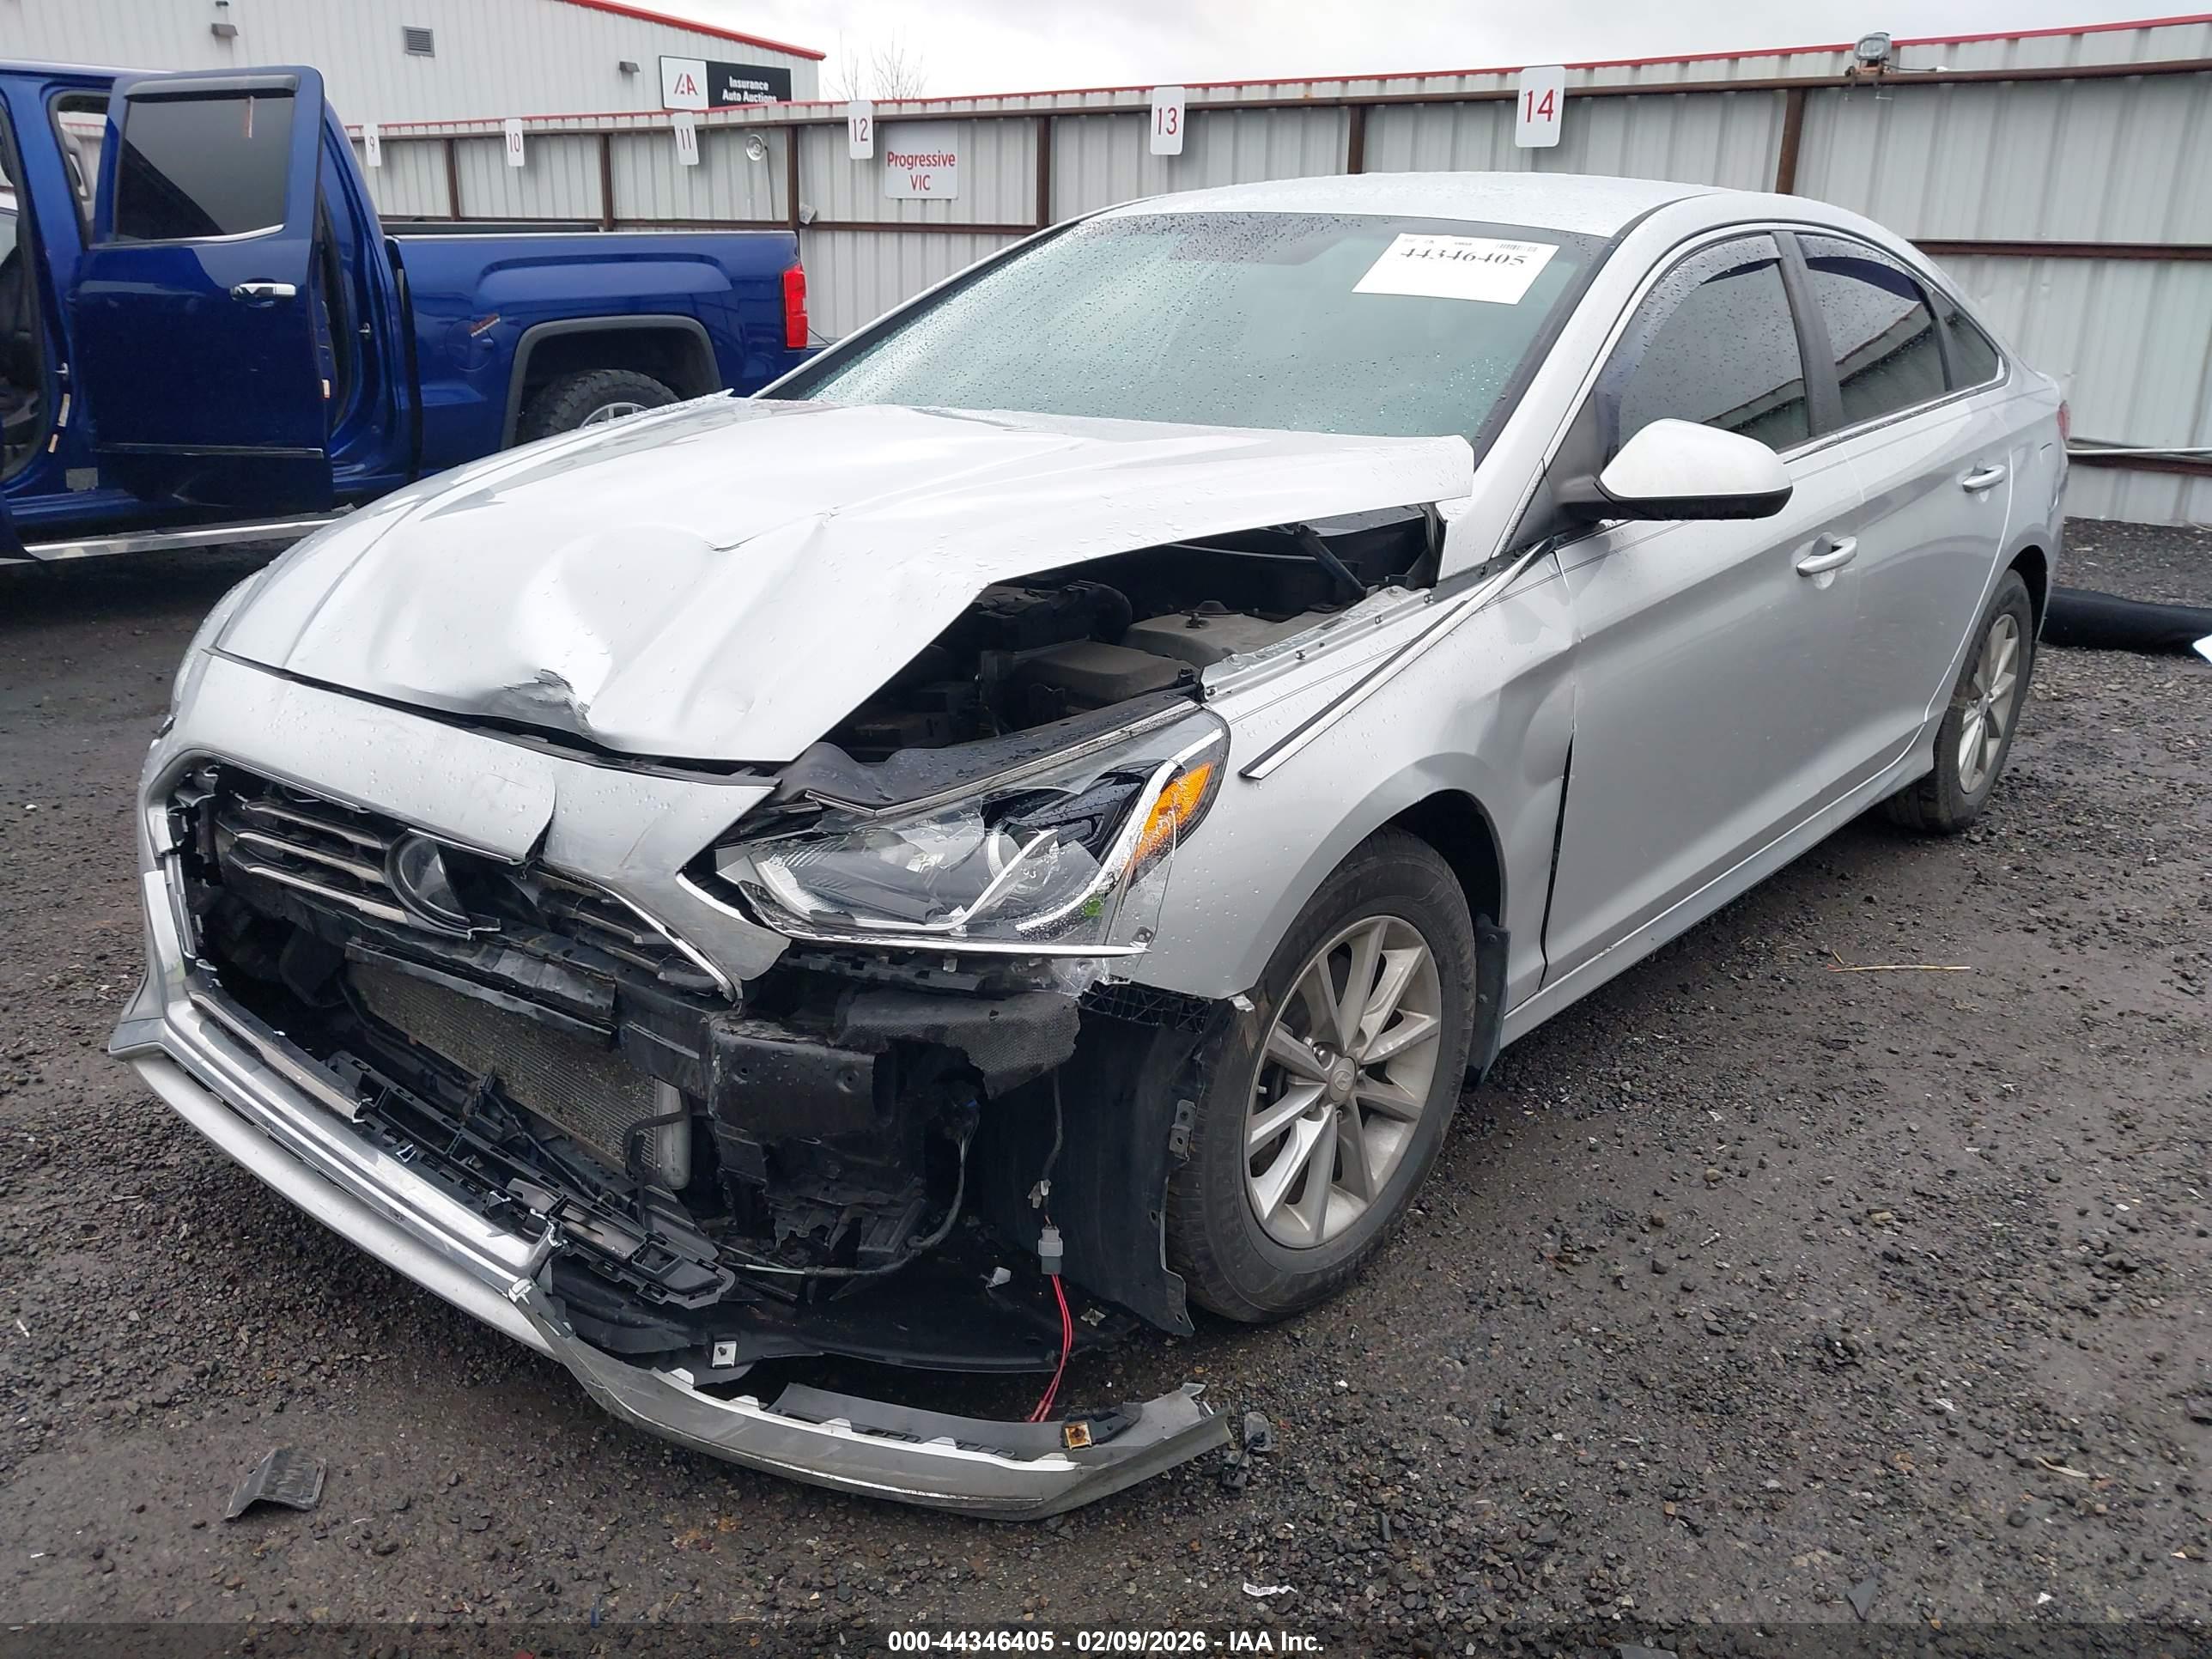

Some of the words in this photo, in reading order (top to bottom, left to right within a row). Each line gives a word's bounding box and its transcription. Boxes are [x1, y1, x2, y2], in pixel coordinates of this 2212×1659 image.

[729, 76, 769, 90] Insurance
[722, 88, 741, 102] Auto
[743, 91, 777, 103] Auctions
[1526, 89, 1554, 123] 14
[853, 118, 869, 143] 12
[1157, 106, 1177, 135] 13
[369, 136, 375, 153] 9
[508, 132, 521, 152] 10
[680, 127, 692, 150] 11
[887, 149, 956, 170] Progressive
[910, 174, 931, 191] VIC
